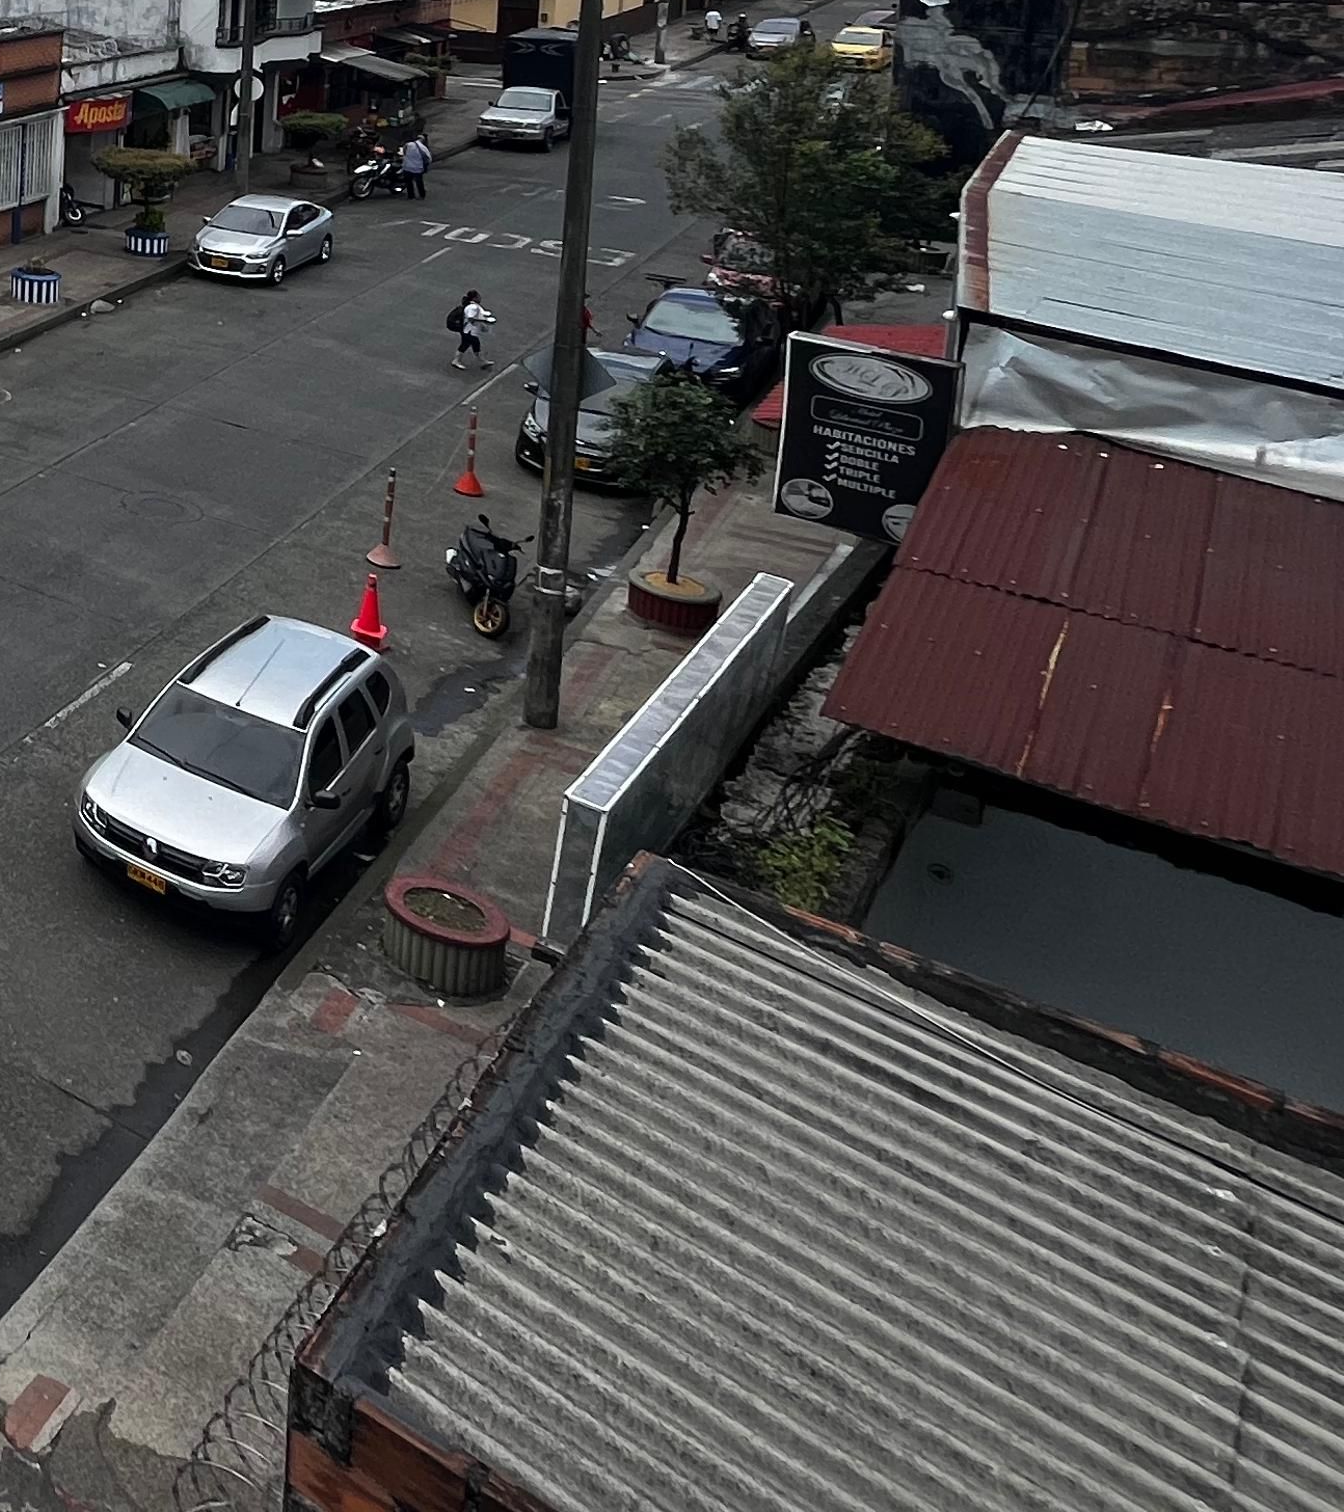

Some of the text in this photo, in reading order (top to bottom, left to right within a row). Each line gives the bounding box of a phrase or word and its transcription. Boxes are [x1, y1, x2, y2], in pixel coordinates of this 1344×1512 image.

[813, 424, 916, 456] HABITACIONES
[840, 455, 880, 471] DOBLE
[841, 443, 899, 463] SENCILLA
[839, 465, 881, 483] TRIPLE
[837, 477, 896, 499] MULTIPLE
